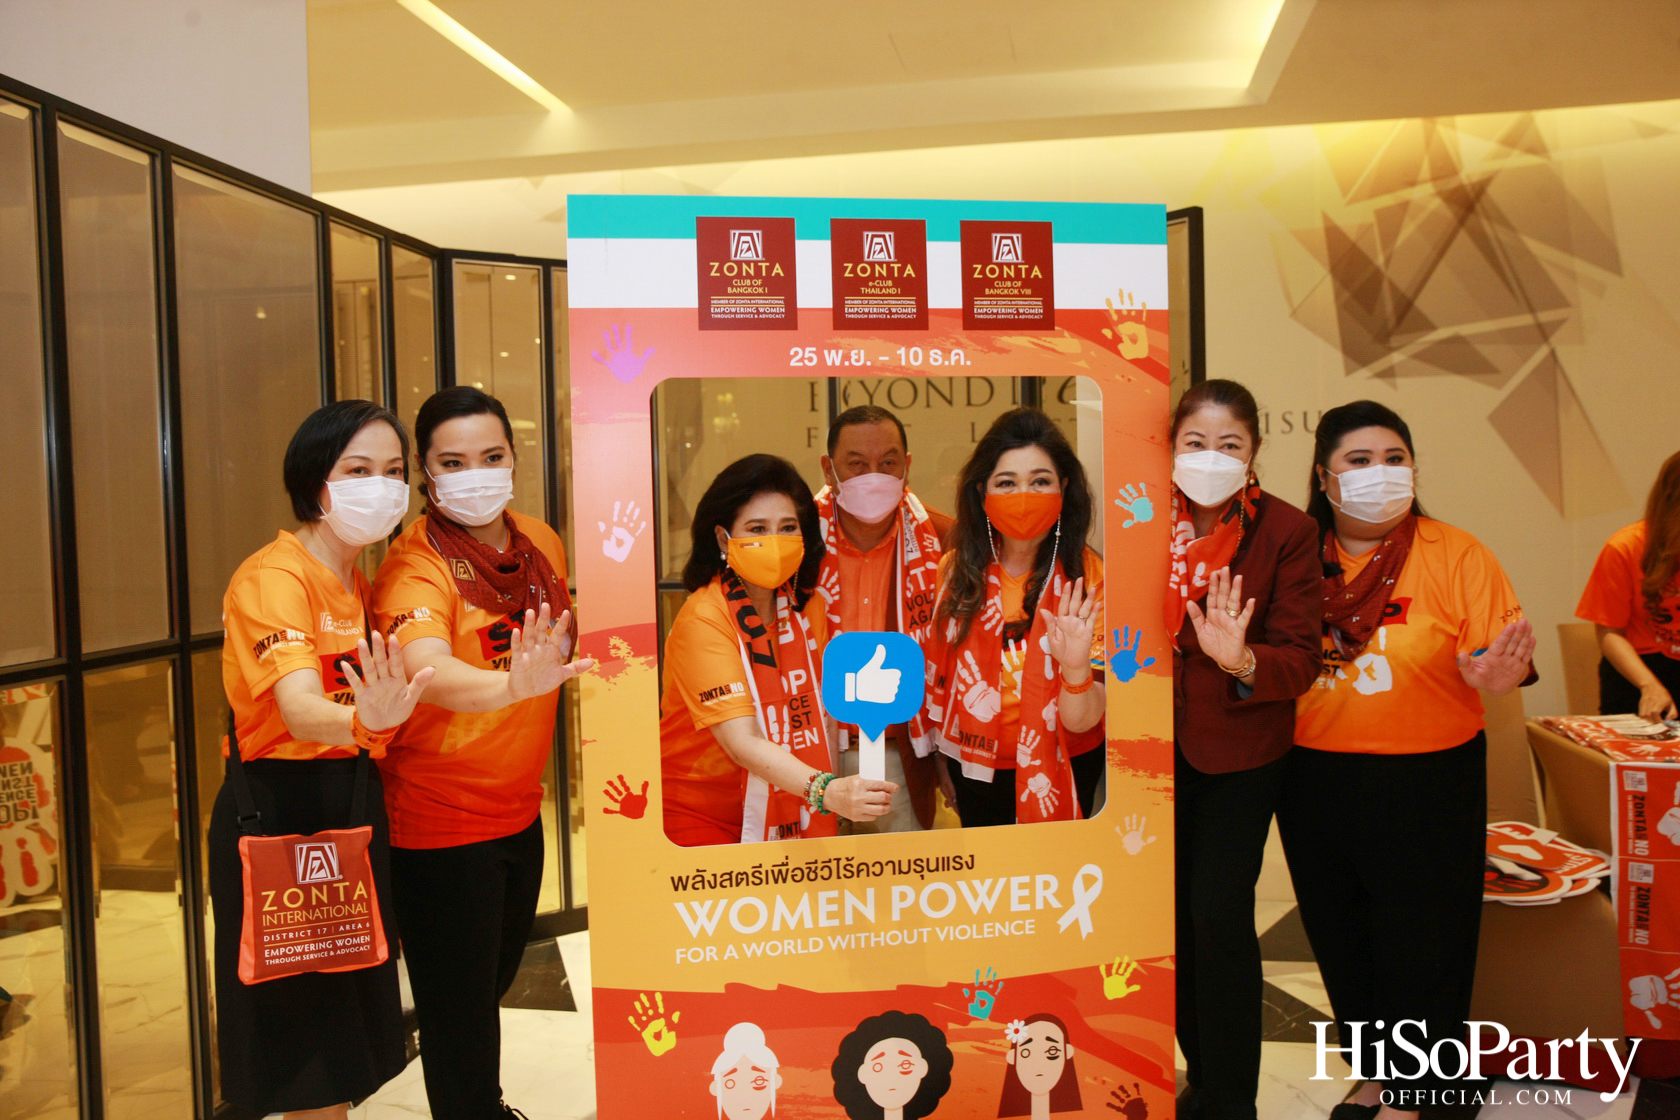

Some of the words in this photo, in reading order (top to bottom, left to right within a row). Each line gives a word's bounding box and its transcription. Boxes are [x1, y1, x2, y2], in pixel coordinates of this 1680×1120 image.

[709, 262, 784, 277] ZONTA
[843, 263, 916, 278] ZONTA
[973, 264, 1042, 279] ZONTA
[790, 347, 818, 366] 25
[824, 348, 872, 366] พ.ย.
[897, 348, 923, 366] 10
[929, 348, 971, 366] ธ.ค.
[413, 606, 431, 620] NO
[253, 633, 280, 659] ZONTA
[699, 686, 725, 703] ZONTA
[730, 682, 745, 694] NO
[1633, 795, 1647, 832] ZONTA
[1634, 840, 1649, 856] NO
[670, 854, 975, 892] พลังสตรีเพื่อชีวีไร้ความรุนแรง
[261, 880, 368, 911] ZONTA
[674, 887, 876, 938] WOMEN
[891, 873, 1063, 922] POWER
[1636, 887, 1651, 922] ZONTA
[262, 902, 369, 927] INTERNATIONAL
[264, 930, 312, 942] DISTRICT
[339, 923, 363, 931] AREA
[675, 946, 719, 964] FOR
[723, 944, 740, 961] A
[742, 937, 823, 959] WORLD
[828, 927, 932, 951] WITHOUT
[935, 919, 1036, 943] VIOLENCE
[1634, 929, 1649, 945] NO
[264, 941, 333, 958] EMPOWERING
[335, 935, 371, 947] WOMEN
[265, 955, 301, 966] THROUGH
[302, 952, 328, 961] SERVICE
[336, 945, 371, 955] ADVOCACY
